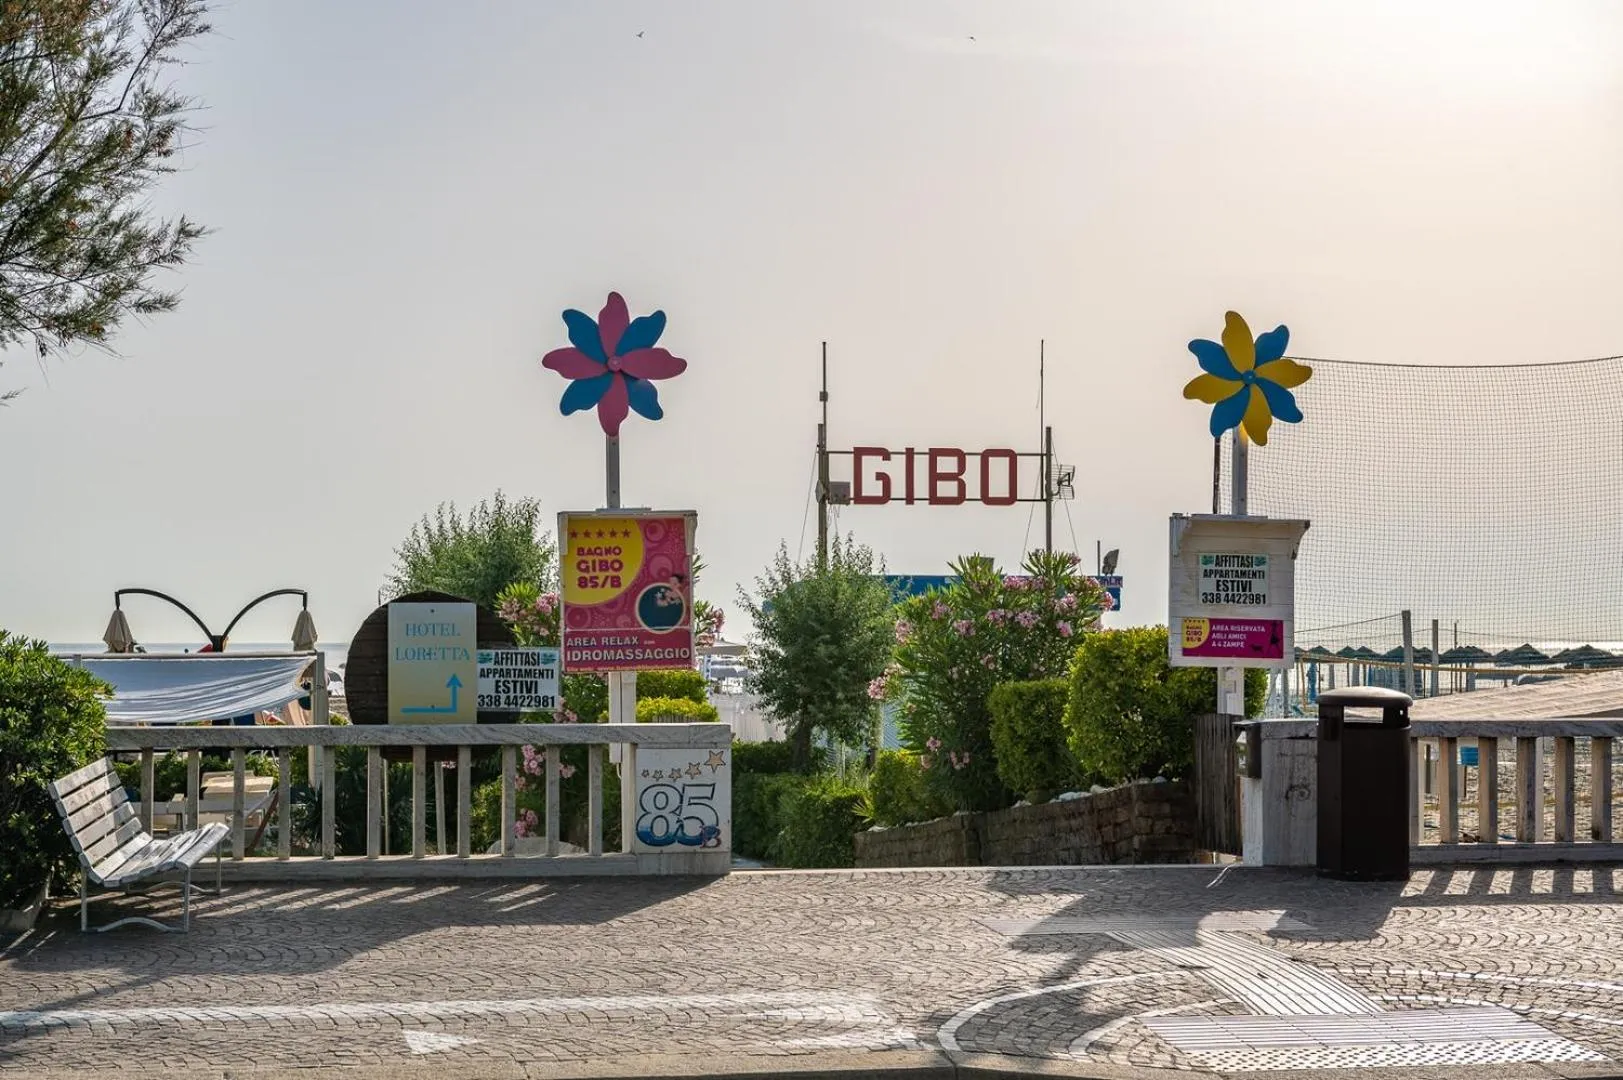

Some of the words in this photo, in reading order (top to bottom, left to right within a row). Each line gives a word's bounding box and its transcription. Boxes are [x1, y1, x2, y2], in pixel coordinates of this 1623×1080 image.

[853, 447, 1017, 506] GIBO
[576, 545, 622, 557] BAGNO
[576, 559, 624, 573] GIBO
[1214, 554, 1254, 568] AFFITTASI
[1203, 569, 1265, 579] APPARTAMENTI
[577, 575, 622, 589] 85/B
[1215, 579, 1252, 593] ESTIVI
[1201, 592, 1221, 604] 338
[1223, 592, 1267, 605] 4422981
[405, 622, 461, 637] HOTEL
[1211, 624, 1229, 632] AREA
[1230, 624, 1266, 633] RISERVATA
[566, 637, 597, 647] AREA
[601, 635, 639, 646] RELAX
[1211, 632, 1227, 640] AGLI
[395, 646, 471, 661] LORETTA
[493, 651, 541, 666] AFFITTASI
[566, 647, 690, 662] IDROMASSAGGIO
[479, 668, 554, 679] APPARTAMENTI
[494, 680, 539, 695] ESTIVI
[477, 694, 501, 708] 338
[503, 694, 556, 708] 4422981
[636, 783, 719, 847] 85
